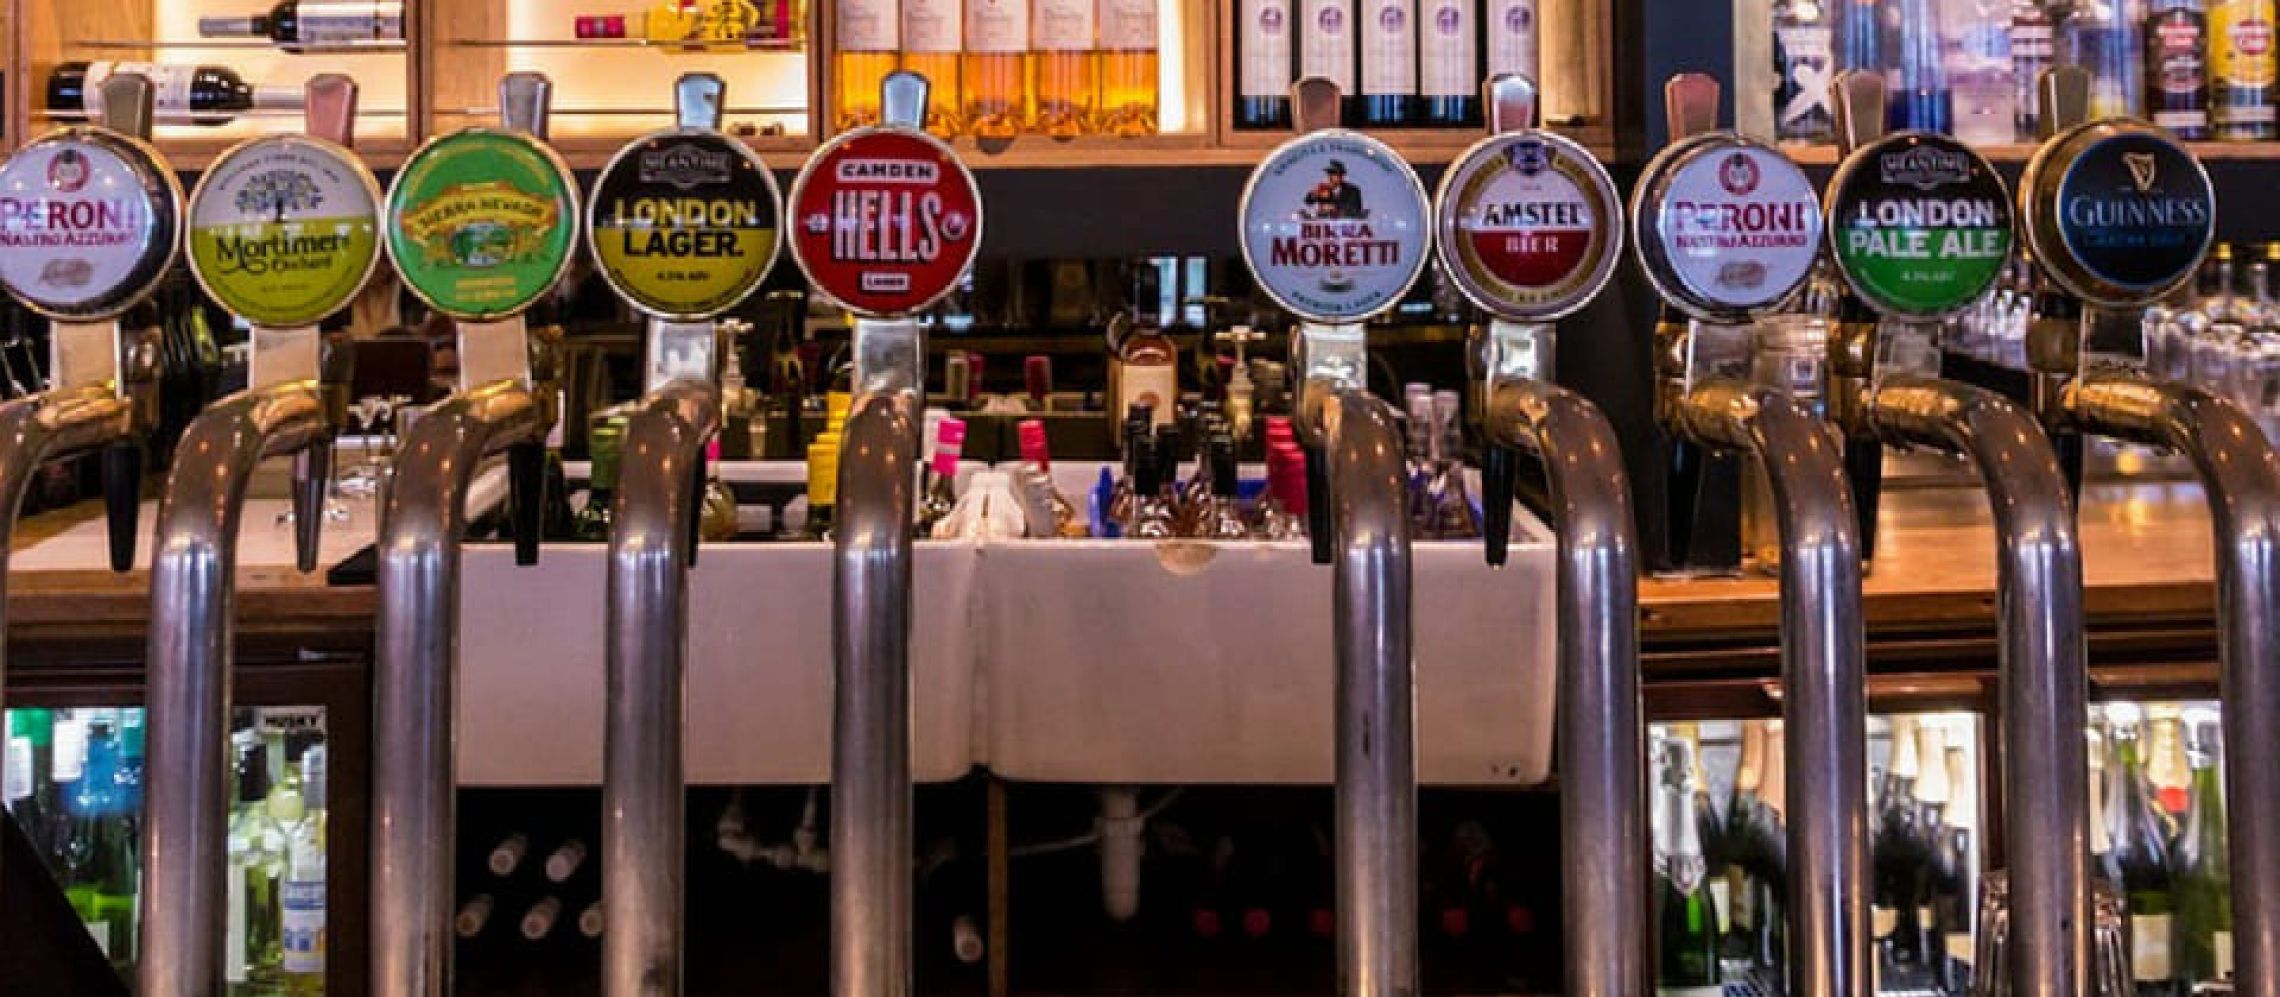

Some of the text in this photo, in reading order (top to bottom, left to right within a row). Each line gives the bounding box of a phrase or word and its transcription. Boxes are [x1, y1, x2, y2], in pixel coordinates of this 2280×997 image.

[842, 164, 933, 178] CAMDEN
[0, 197, 137, 229] PERONI
[614, 197, 758, 228] LONDON
[834, 190, 942, 261] HELLS
[1483, 200, 1584, 227] AMSTEL
[1675, 200, 1807, 232] PERONI
[1856, 198, 1995, 227] LONDON
[2068, 195, 2207, 227] GUINNESS
[624, 231, 745, 258] LAGER.
[1301, 222, 1374, 239] BIRRA
[1504, 235, 1560, 253] BIER
[1849, 229, 1931, 259] PALE
[1271, 236, 1400, 267] MORETTI
